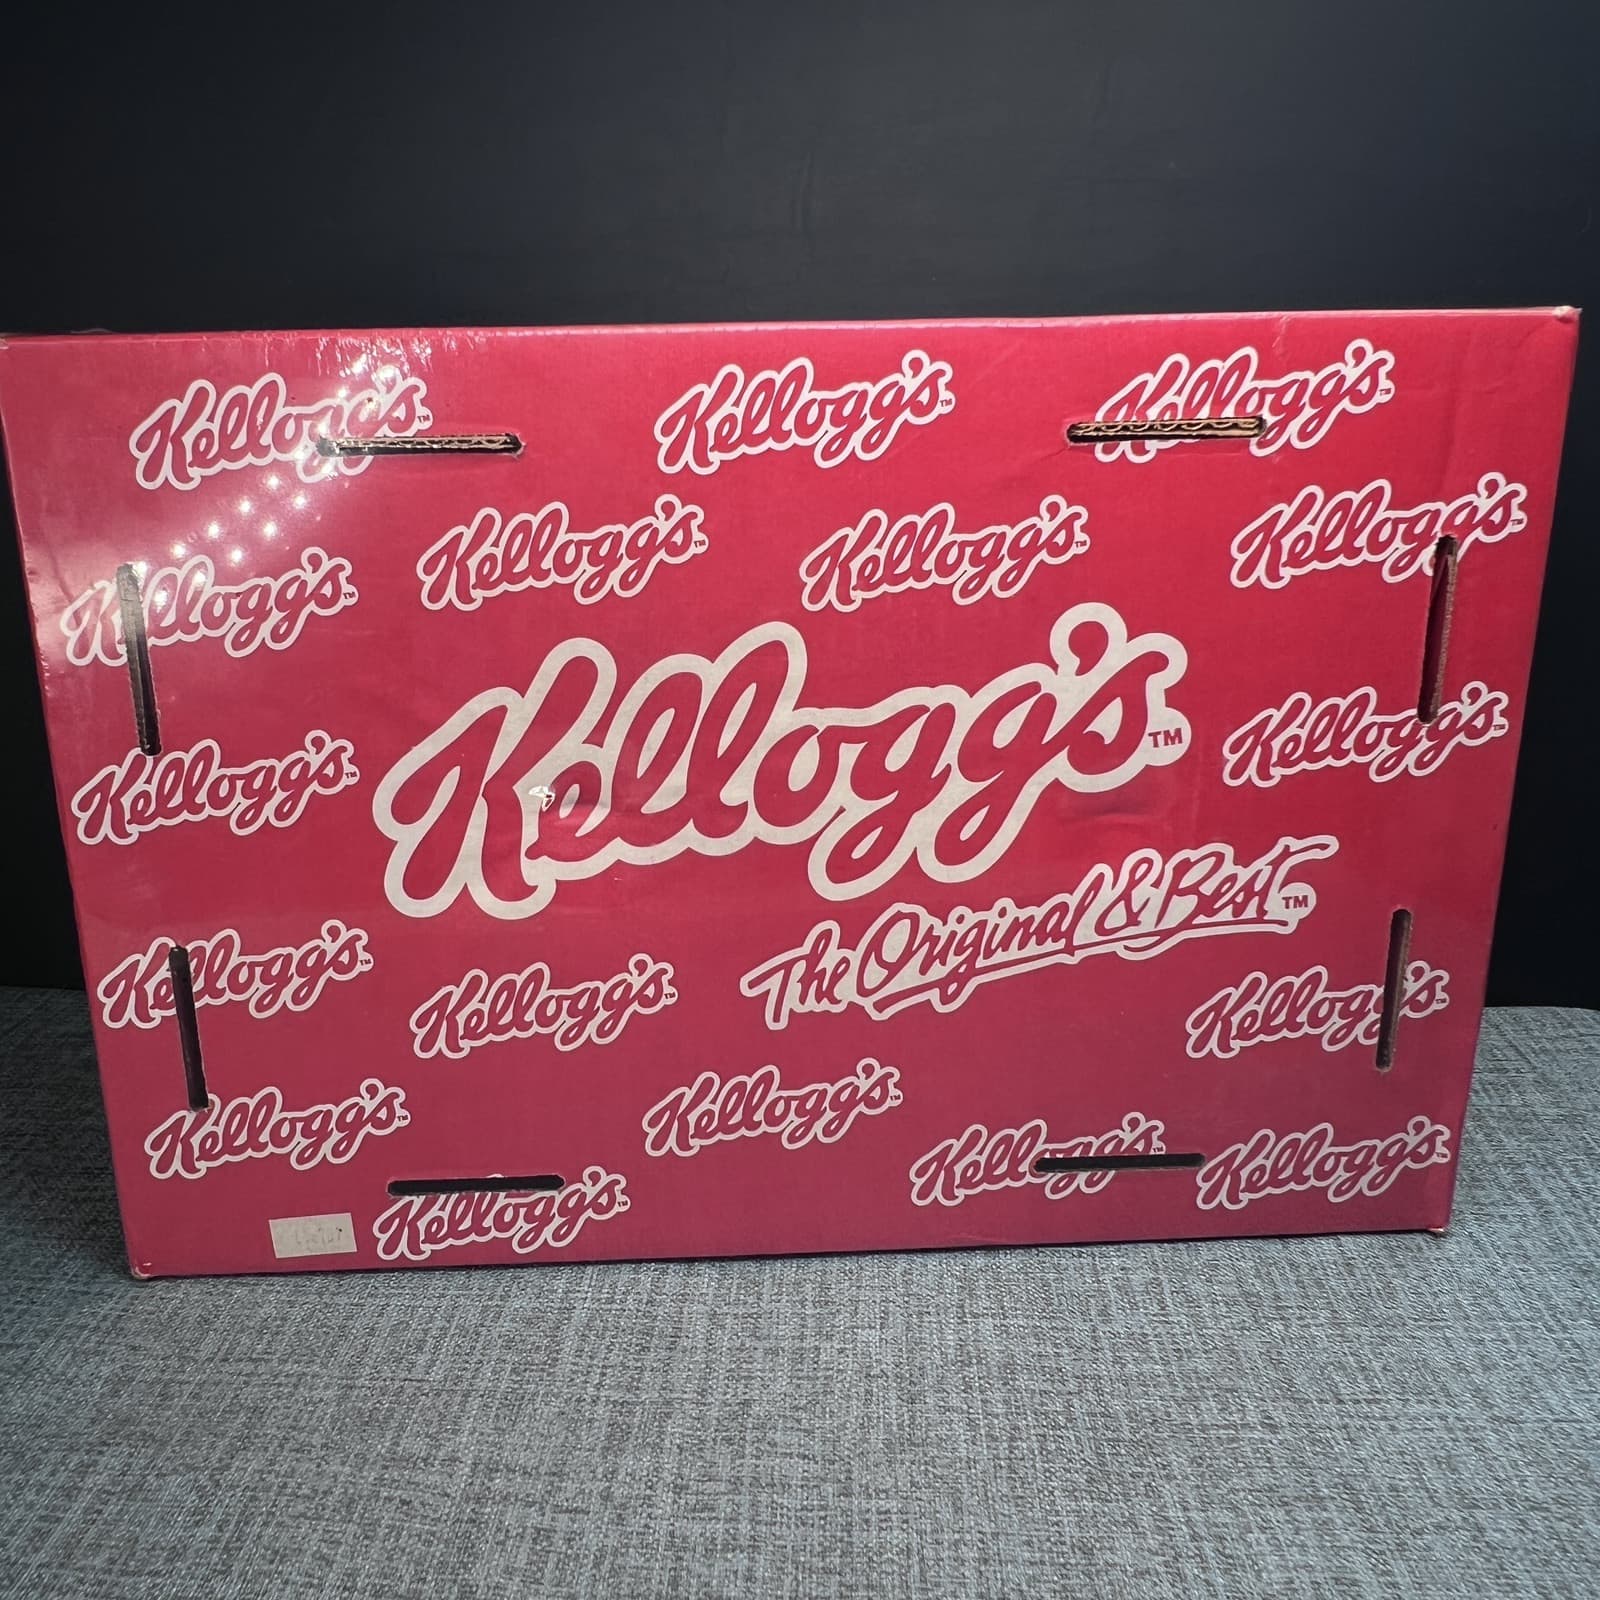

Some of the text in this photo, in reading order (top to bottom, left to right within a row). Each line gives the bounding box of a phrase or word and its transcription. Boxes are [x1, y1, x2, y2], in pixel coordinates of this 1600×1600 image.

[659, 356, 948, 469] Kellogg's
[421, 499, 698, 605] Kellogg's
[804, 500, 1083, 607] Kellogg's
[1234, 478, 1522, 584] Kellogg's
[66, 551, 347, 661] Kllogg's
[388, 621, 1184, 903] Kellogg's TM
[1228, 686, 1503, 782] Kellogg's
[77, 735, 348, 841] Kellogg's
[747, 843, 1332, 1024] The Original & Best TM
[414, 957, 670, 1054] Kellogg's
[1190, 964, 1445, 1054] Kellog's
[149, 1082, 402, 1175] Kellogg's
[646, 1061, 896, 1153] Kellogg's
[377, 1170, 623, 1257] Kellogg's
[1199, 1119, 1446, 1207] Kellogg's
